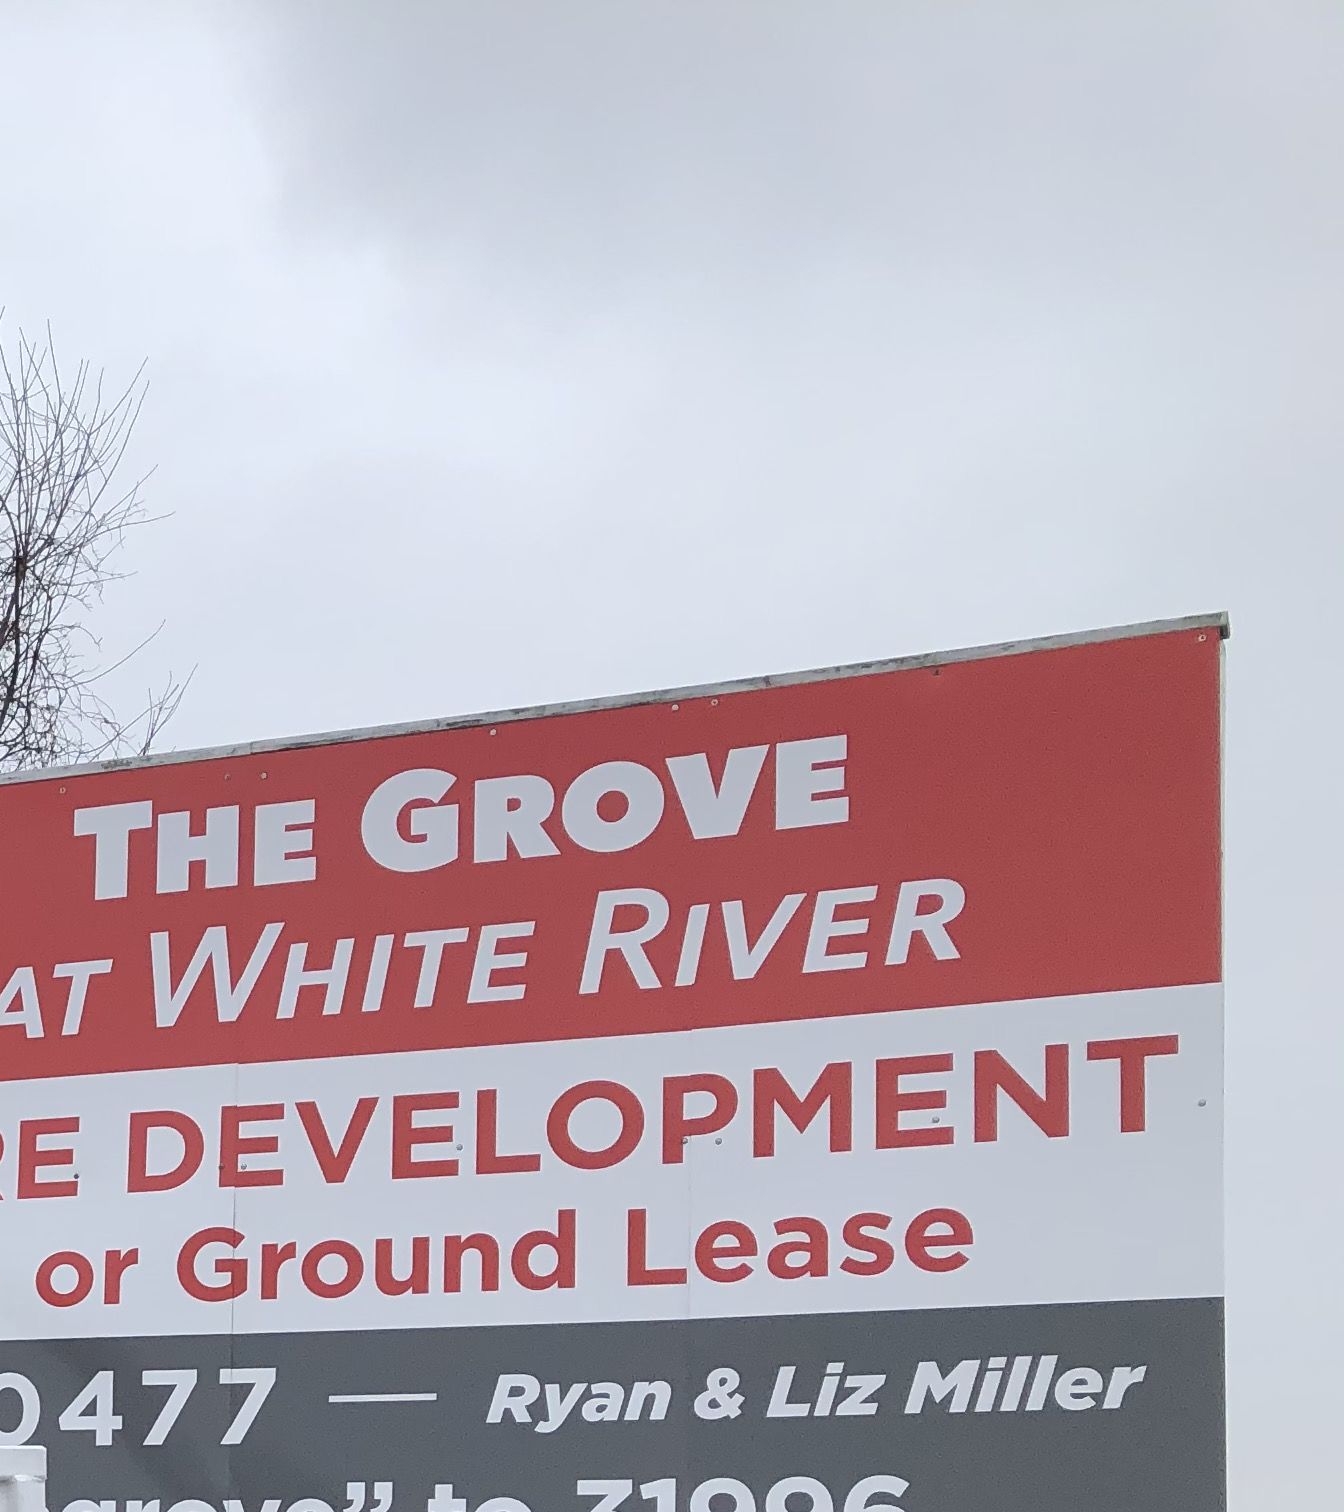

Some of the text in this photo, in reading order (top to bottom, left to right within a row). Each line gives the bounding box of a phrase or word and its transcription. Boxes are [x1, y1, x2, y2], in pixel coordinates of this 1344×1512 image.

[73, 734, 849, 900] THE GROVE
[150, 920, 535, 1027] WHITE
[578, 877, 967, 995] RIVER
[128, 1034, 1179, 1194] DEVELOPMENT
[35, 1246, 138, 1307] or
[176, 1208, 576, 1302] Ground
[627, 1206, 974, 1286] Lease
[485, 1372, 669, 1433] Ryan
[693, 1367, 745, 1418] &
[766, 1361, 887, 1418] Liz
[905, 1355, 1147, 1414] Miller
